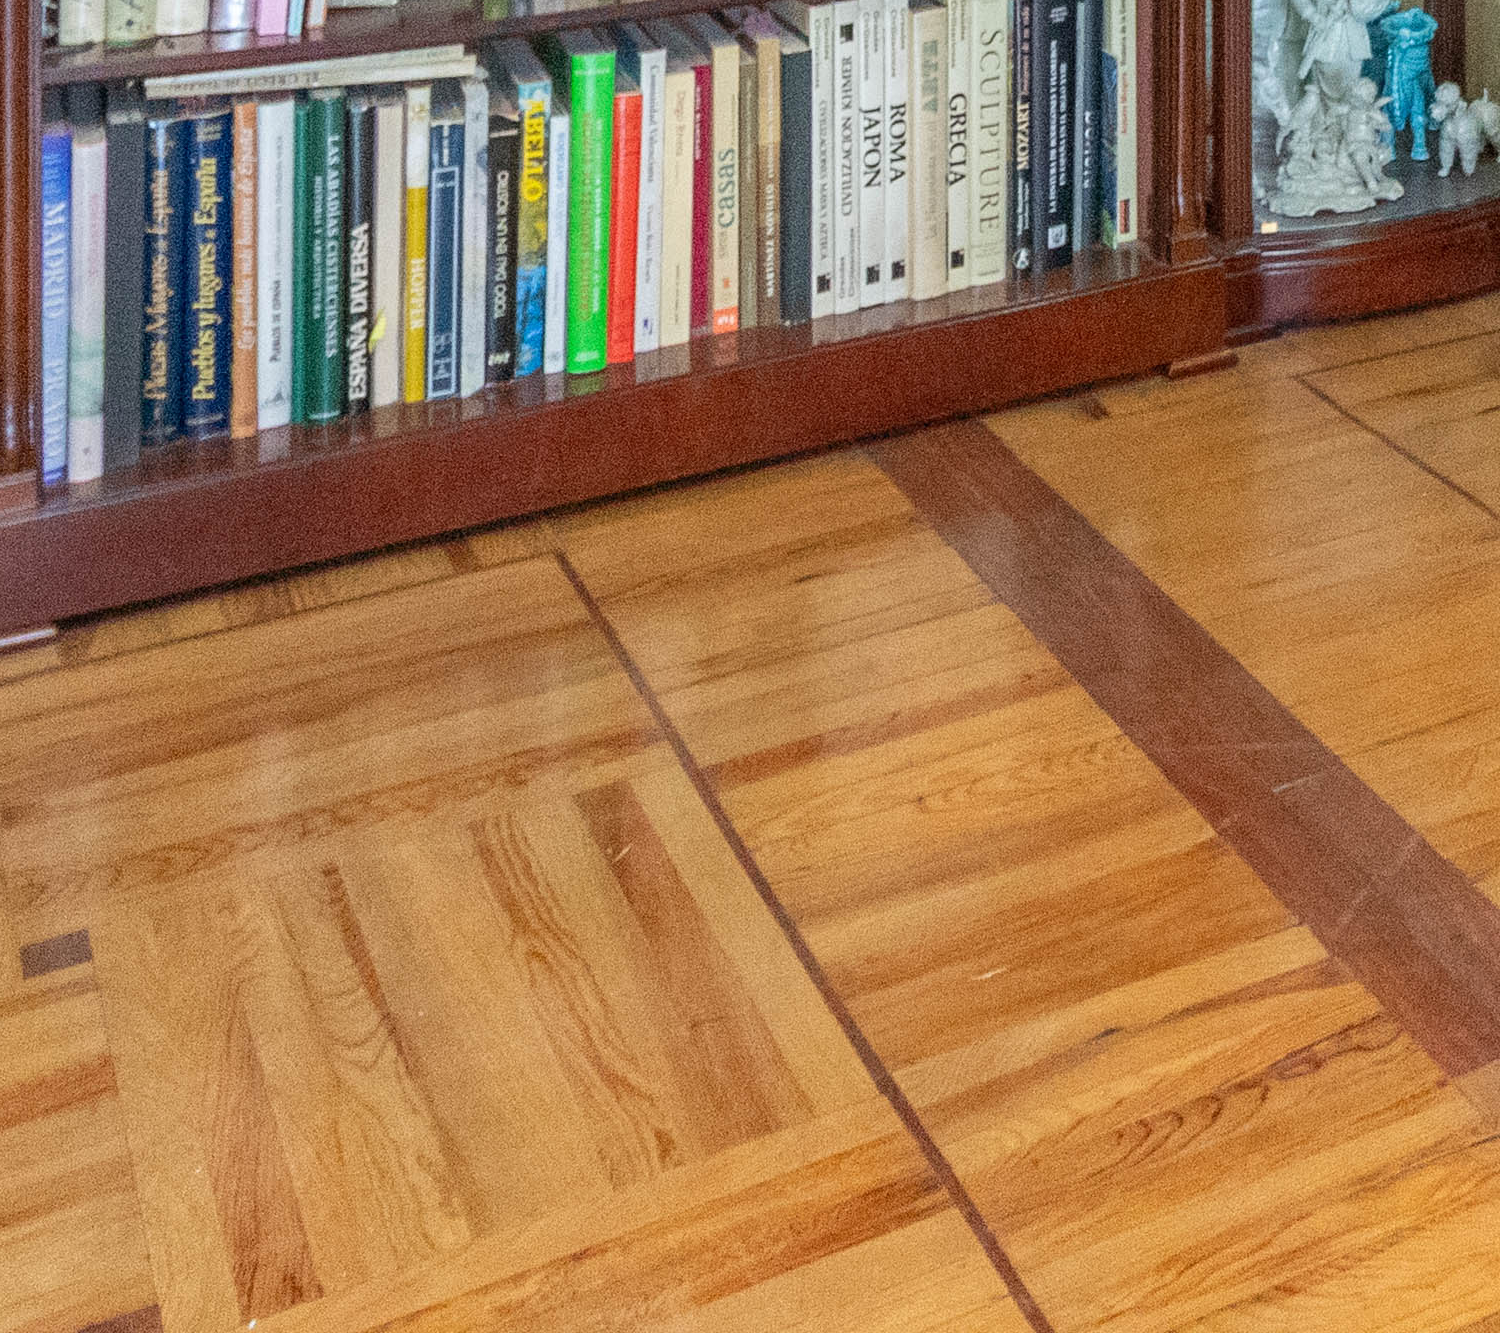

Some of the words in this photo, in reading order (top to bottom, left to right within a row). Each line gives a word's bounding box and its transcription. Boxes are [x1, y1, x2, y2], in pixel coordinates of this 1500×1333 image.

[840, 56, 853, 110] KHMER
[1060, 86, 1068, 112] SIGLO
[327, 134, 340, 166] LAS
[859, 106, 881, 189] JAPON
[889, 103, 906, 184] ROMA
[945, 92, 967, 187] GRECIA
[979, 28, 1004, 234] SCULPTURE
[1016, 101, 1030, 171] MOZART
[1050, 95, 1058, 147] BODEGONES
[1058, 139, 1067, 171] ESPAÑA
[194, 157, 222, 225] España
[314, 175, 323, 226] HISTORIA
[497, 170, 509, 215] ROSTRO
[717, 147, 736, 229] casas
[840, 117, 852, 216] CIVILIZACION
[1049, 161, 1058, 200] PINTURA
[146, 169, 173, 235] España
[326, 169, 341, 237] ABADÍAS
[496, 217, 508, 235] UN
[43, 201, 67, 320] MADRID
[191, 243, 222, 310] lugares
[312, 239, 323, 319] ARQUITECTURA
[350, 222, 369, 314] DIVERSA
[496, 236, 508, 254] EN
[146, 255, 174, 335] Mayores
[197, 312, 222, 326] y
[325, 239, 338, 358] CISTERCIENSES
[410, 257, 426, 331] HOPPER
[494, 285, 507, 319] TODO
[191, 330, 216, 401] Pueblos
[346, 318, 368, 400] ESPAÑA
[42, 358, 63, 459] PRADO
